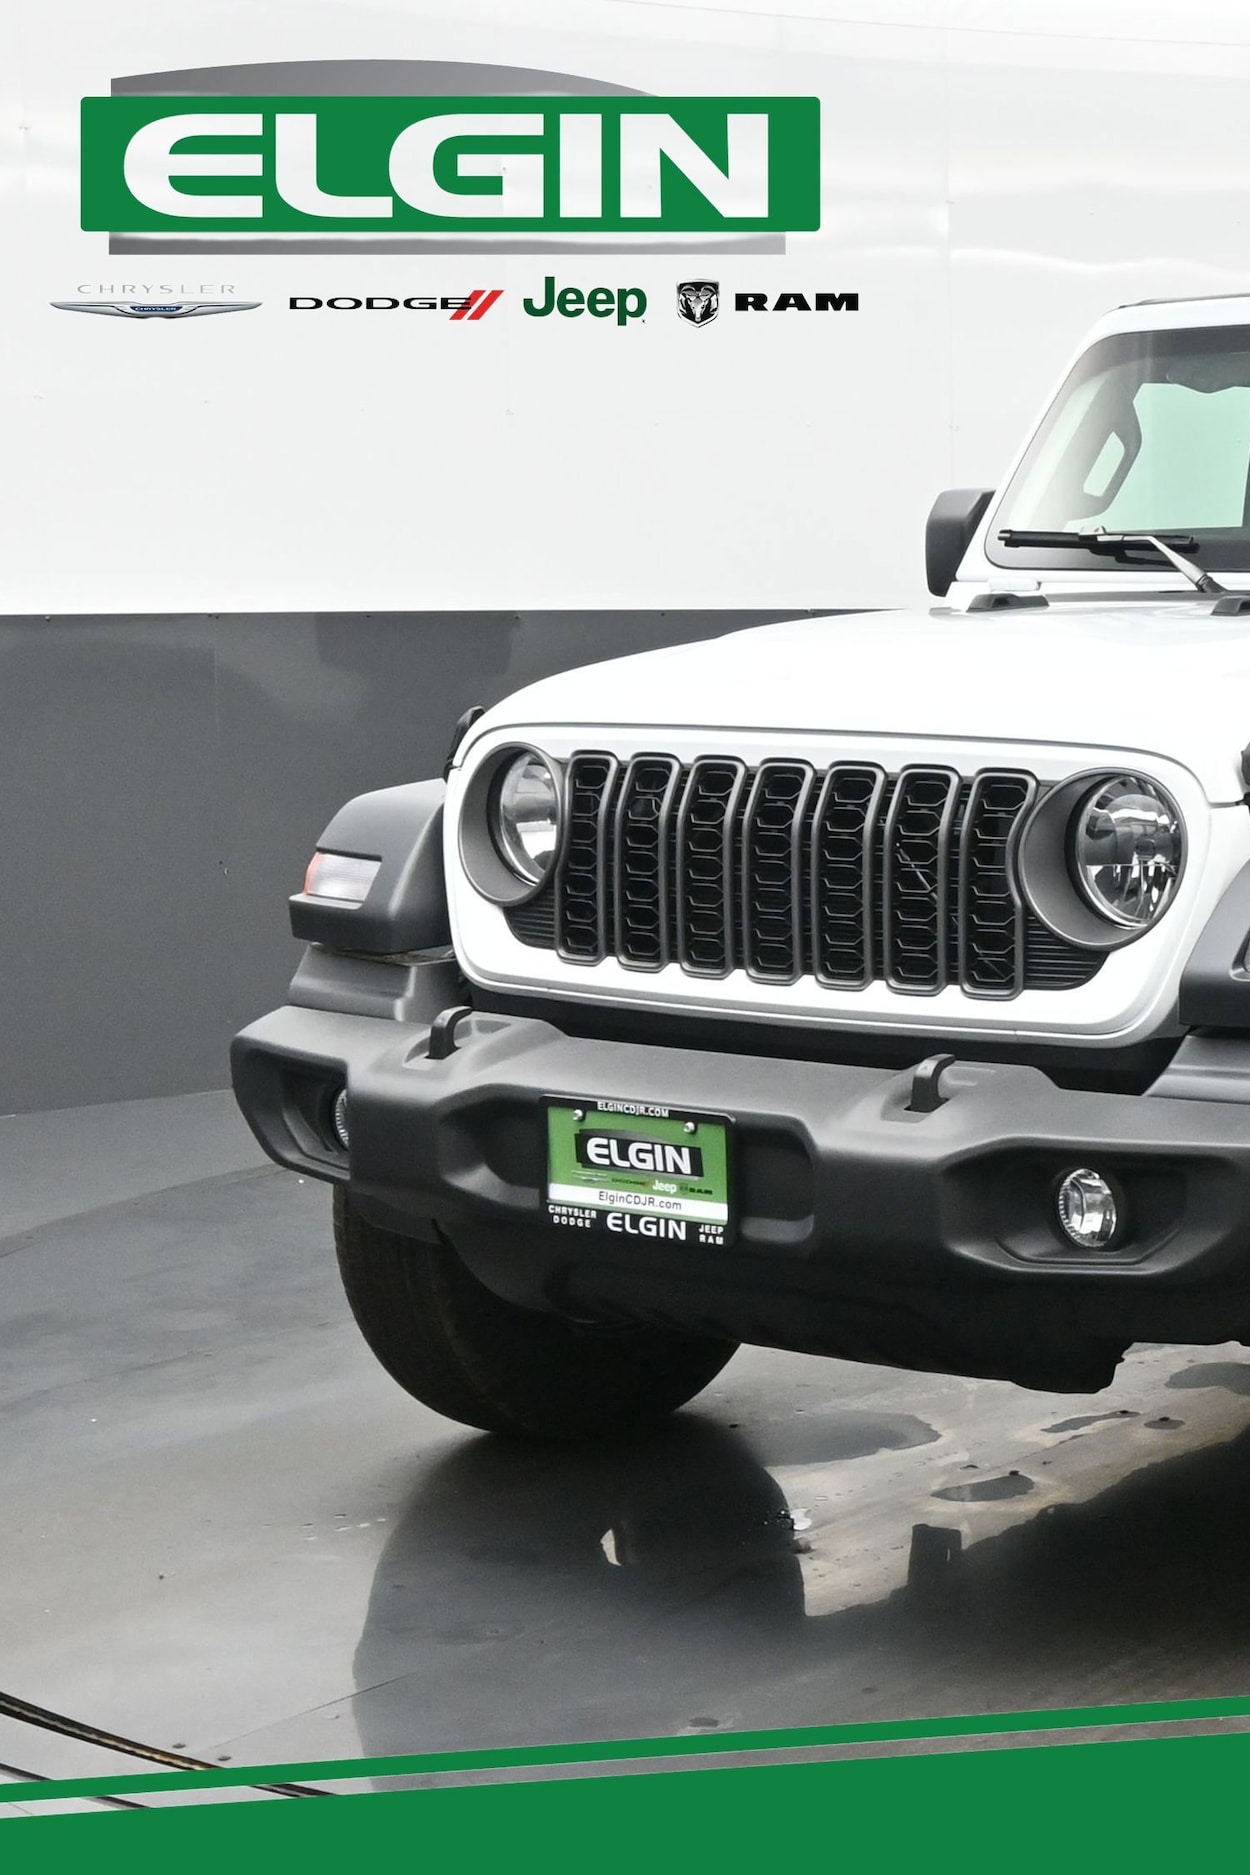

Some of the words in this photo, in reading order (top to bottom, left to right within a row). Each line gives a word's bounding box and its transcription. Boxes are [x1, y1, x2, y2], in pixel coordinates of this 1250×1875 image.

[597, 1101, 670, 1118] ELGINCDJR.COM
[586, 1137, 692, 1175] ELGIN
[652, 1179, 677, 1194] Jeep
[598, 1190, 682, 1211] ElginCDJR.com
[548, 1204, 598, 1219] CHRYSLER
[553, 1215, 592, 1228] DODGE
[606, 1212, 687, 1241] ELGIN
[698, 1224, 725, 1235] JEEP
[699, 1234, 725, 1245] RAM
